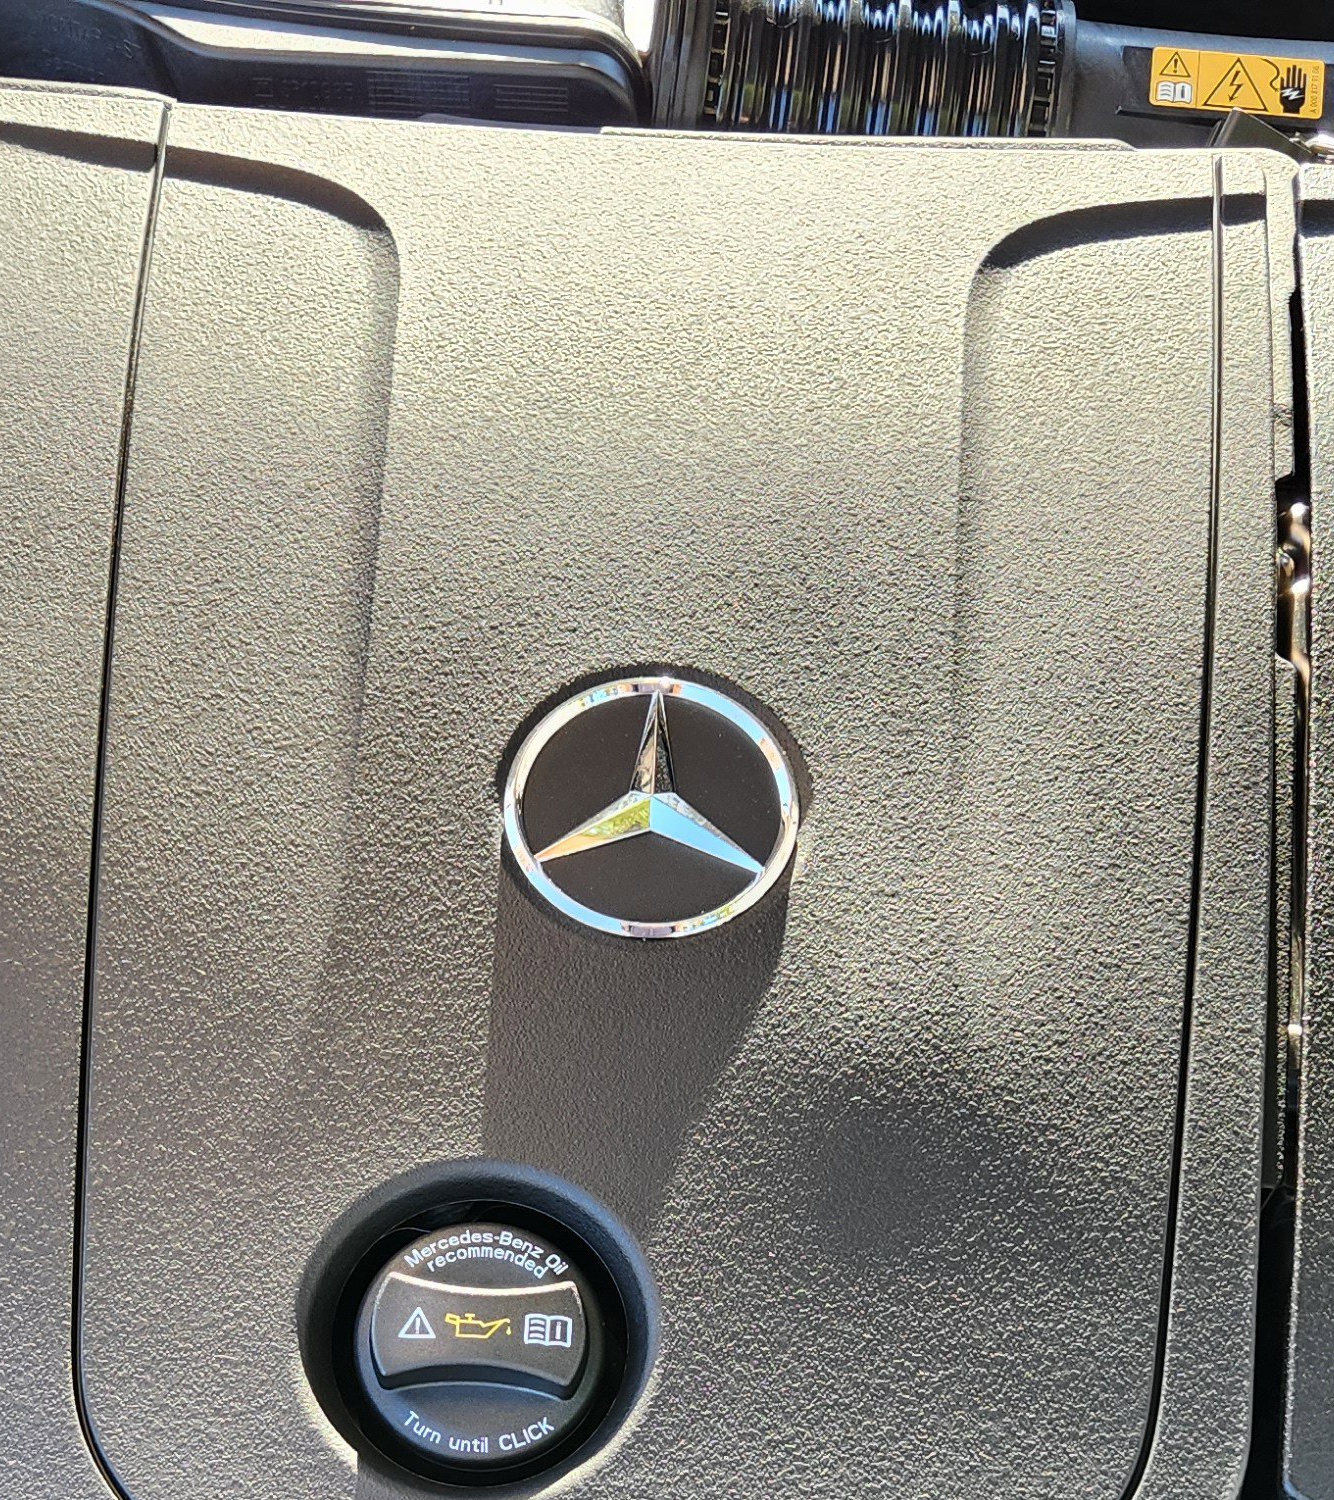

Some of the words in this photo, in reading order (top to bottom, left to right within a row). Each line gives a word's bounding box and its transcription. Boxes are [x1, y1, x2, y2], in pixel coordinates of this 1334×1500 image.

[403, 1230, 544, 1268] Mercedes-Benz
[544, 1252, 570, 1276] Oil
[427, 1246, 550, 1280] recommended
[403, 1410, 442, 1444] Turn
[448, 1435, 489, 1454] until
[498, 1416, 556, 1453] CLICK
